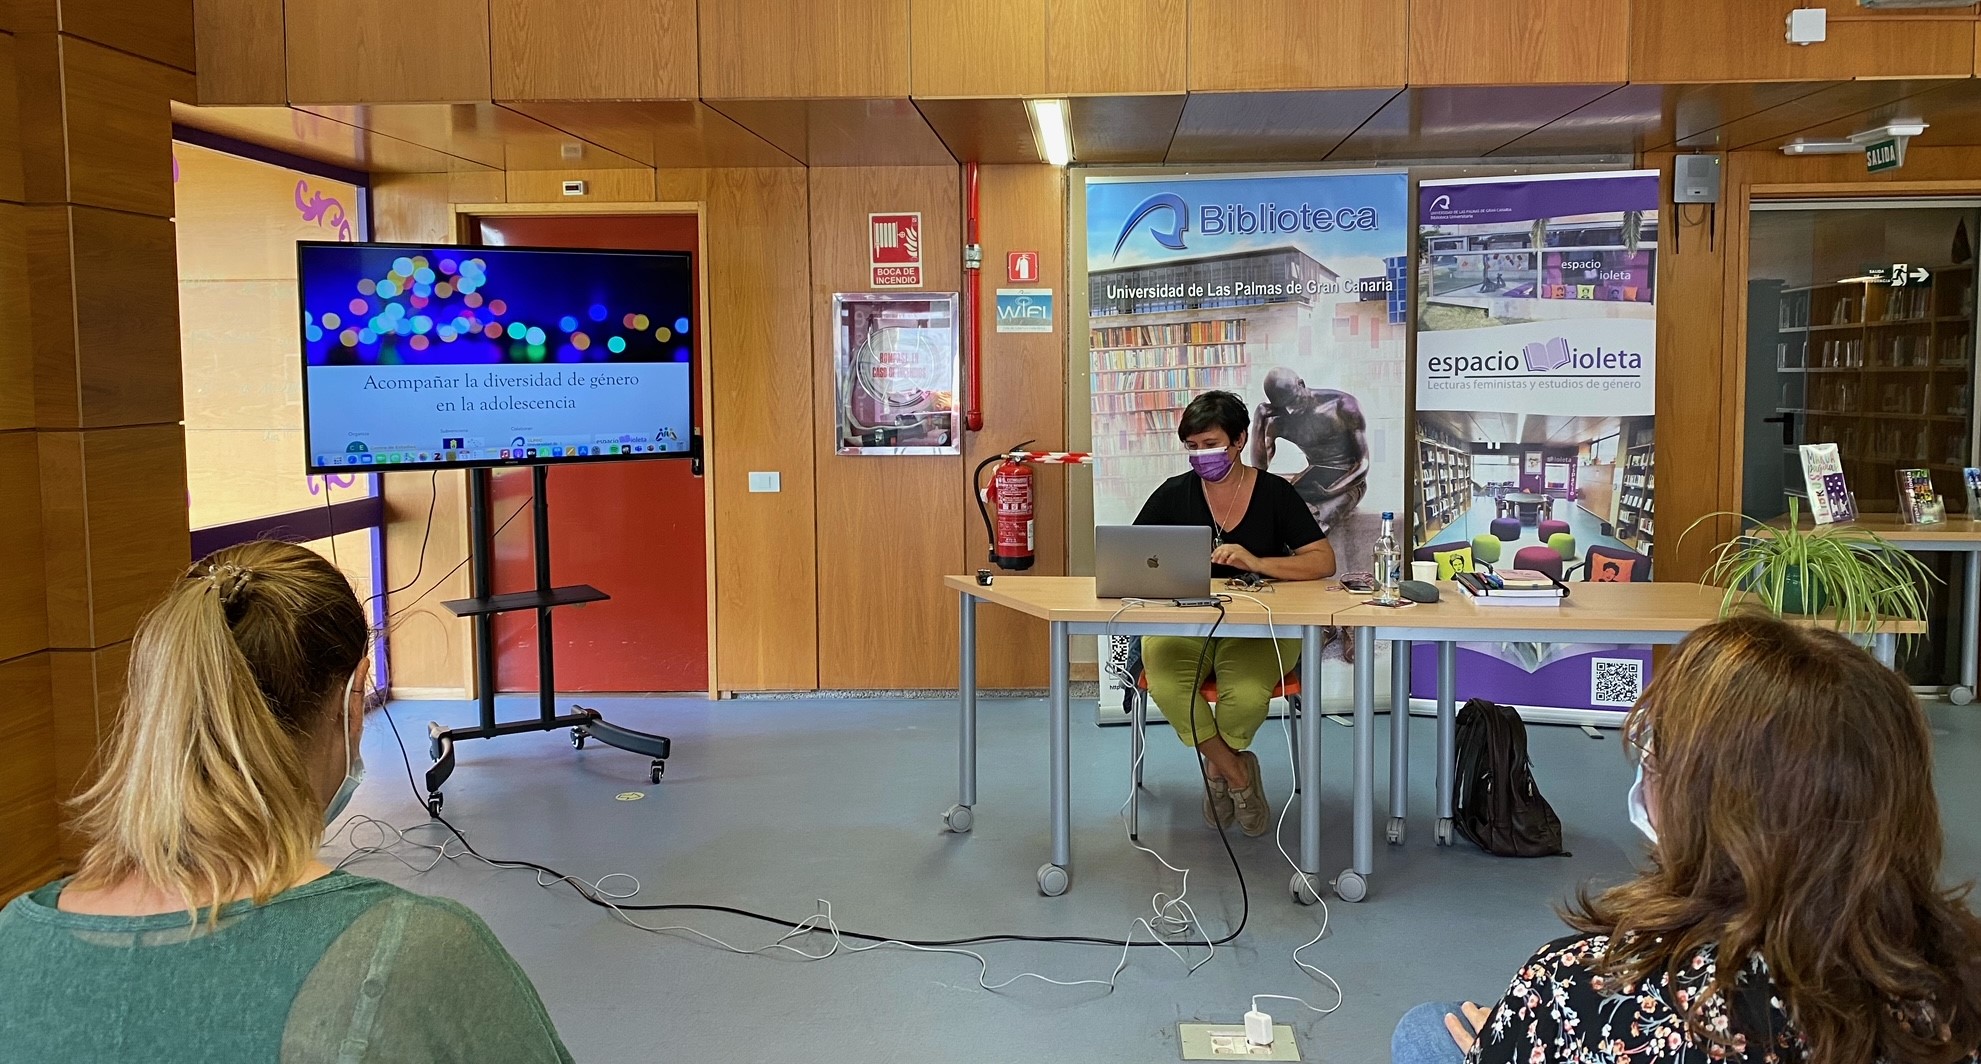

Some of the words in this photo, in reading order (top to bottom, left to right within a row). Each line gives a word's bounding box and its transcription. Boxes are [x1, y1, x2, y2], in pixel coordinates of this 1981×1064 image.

[1866, 145, 1896, 166] SALIDA
[1200, 202, 1379, 235] Biblioteca
[878, 268, 902, 276] BOCA
[1561, 259, 1601, 272] espacio
[876, 276, 917, 285] INCENDIO
[1106, 283, 1184, 300] Universidad
[1187, 282, 1204, 298] de
[1208, 280, 1232, 298] Las
[1234, 278, 1283, 296] Palmas
[1286, 277, 1302, 295] de
[1306, 278, 1339, 294] Gran
[1343, 278, 1394, 293] Canaria
[1428, 350, 1519, 376] espacio
[363, 373, 460, 391] Acompañar
[465, 372, 480, 388] la
[483, 371, 563, 389] diversidad
[567, 370, 586, 388] de
[590, 371, 640, 390] género
[872, 366, 888, 378] CASO
[1428, 380, 1470, 390] Lecturas
[1473, 380, 1528, 390] feministas
[1530, 382, 1536, 392] y
[1538, 379, 1584, 389] estudios
[1586, 378, 1600, 389] de
[1602, 380, 1642, 391] género
[436, 400, 456, 412] en
[461, 396, 474, 412] la
[479, 395, 576, 411] adolescencia
